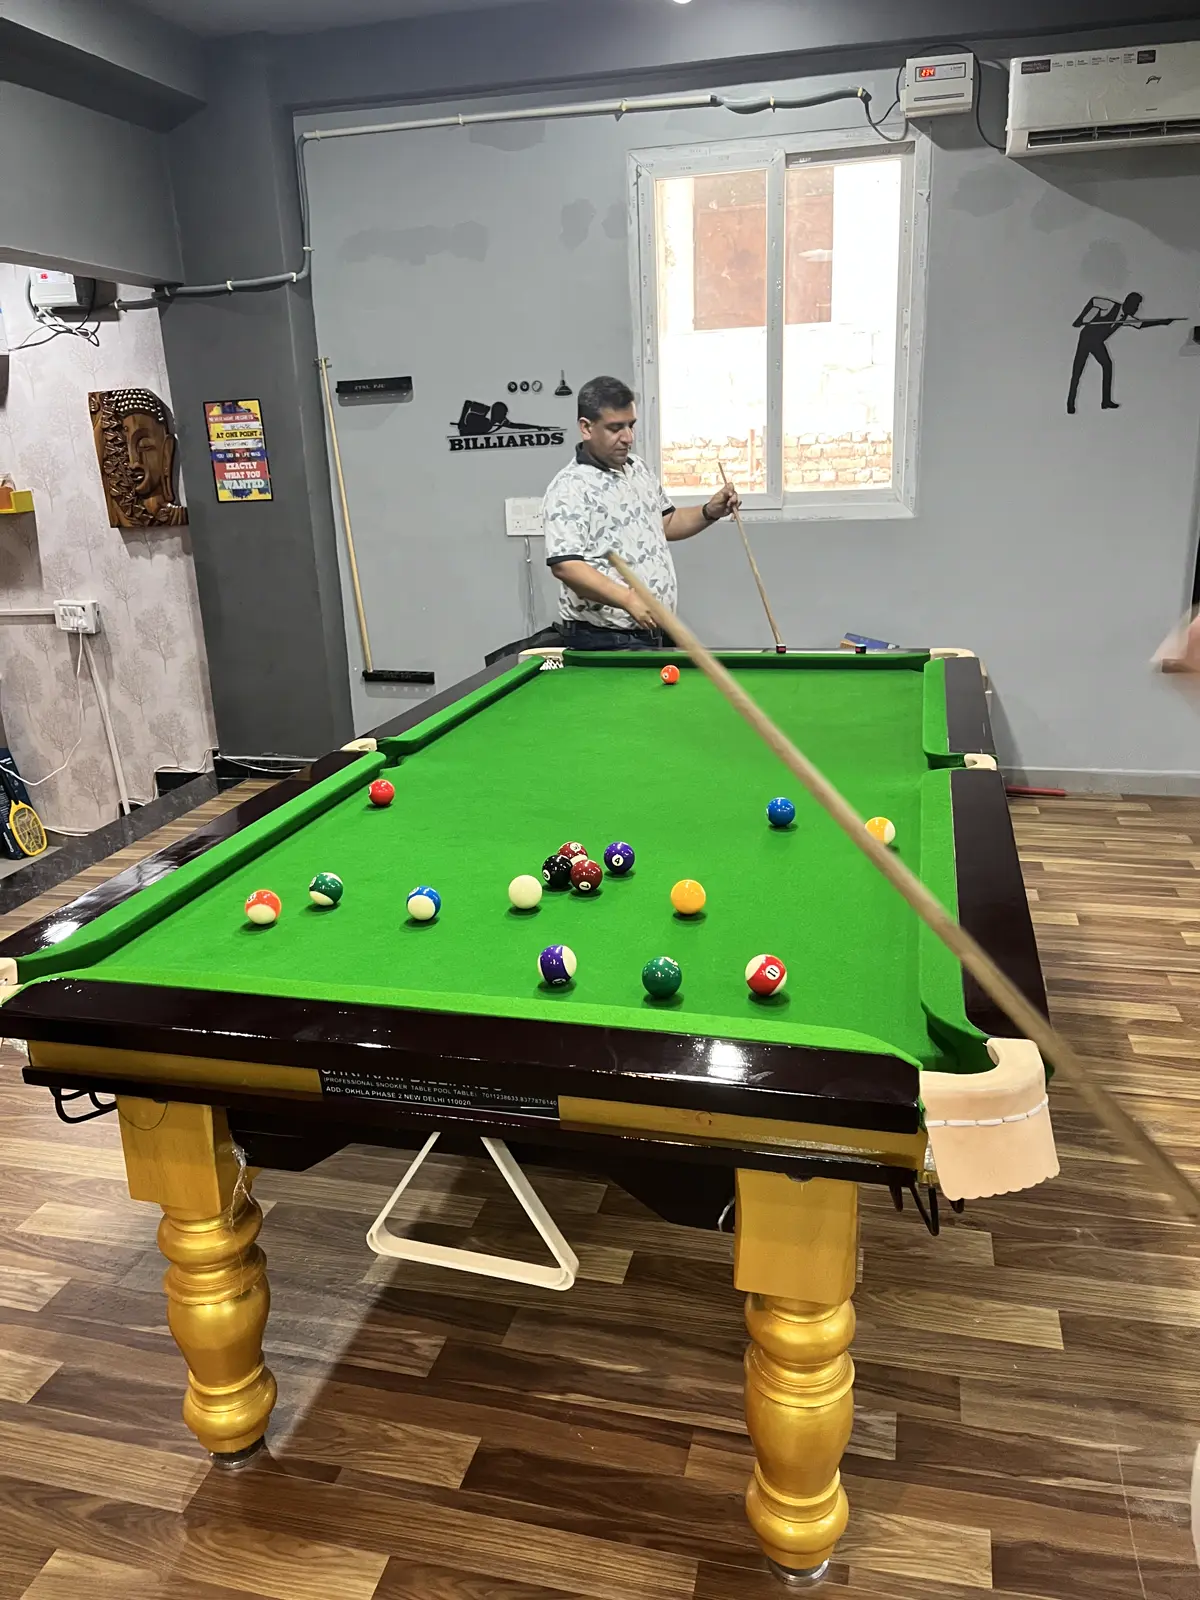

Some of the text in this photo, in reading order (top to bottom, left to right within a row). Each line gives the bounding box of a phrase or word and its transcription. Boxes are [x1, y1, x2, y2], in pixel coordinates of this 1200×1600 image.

[449, 432, 564, 451] BILLIARDS
[225, 462, 257, 470] EXACTLY
[224, 471, 245, 479] WHAT
[223, 480, 265, 490] WANTED
[375, 1082, 408, 1090] SNOOKER
[345, 1088, 370, 1096] OKHLA
[372, 1090, 396, 1098] PHASE
